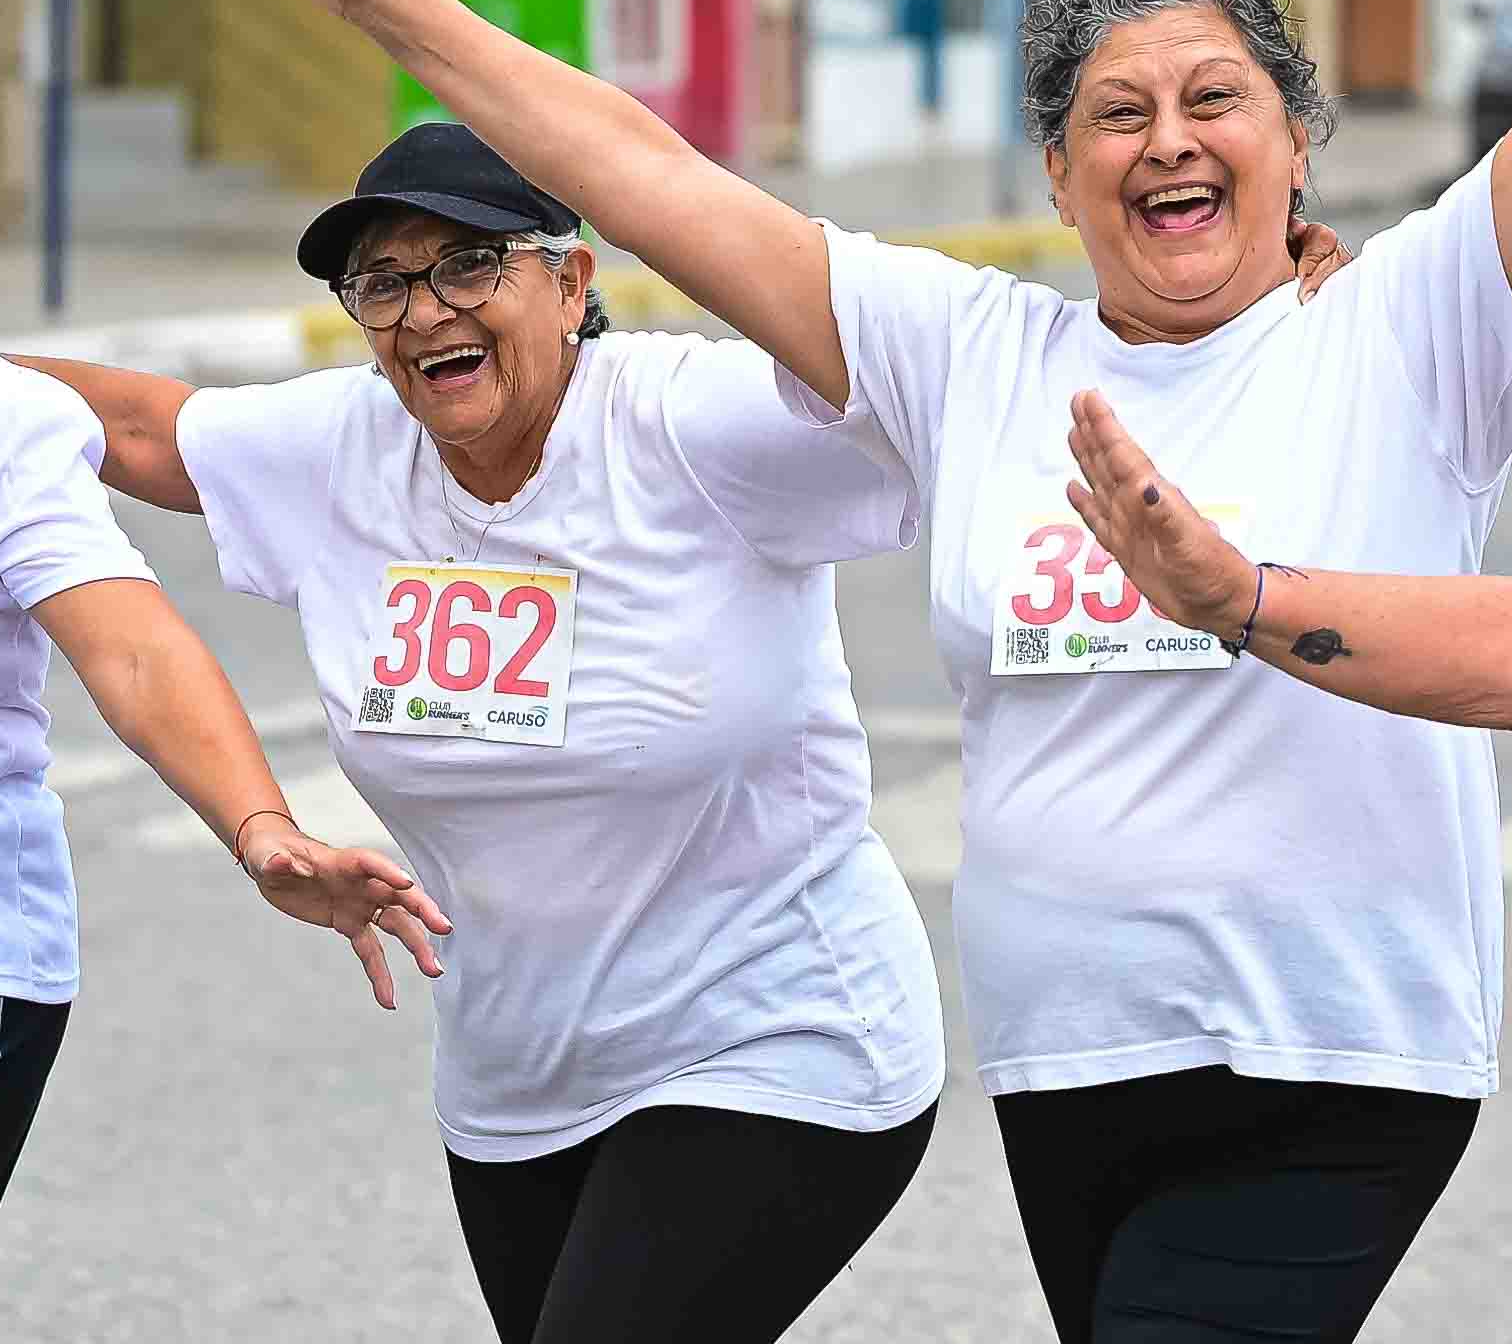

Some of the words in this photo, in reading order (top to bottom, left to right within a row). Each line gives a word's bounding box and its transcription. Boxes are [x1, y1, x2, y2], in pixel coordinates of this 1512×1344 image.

[374, 579, 557, 698] 362
[1145, 637, 1211, 653] CARUSO
[487, 710, 546, 728] CARUSO
